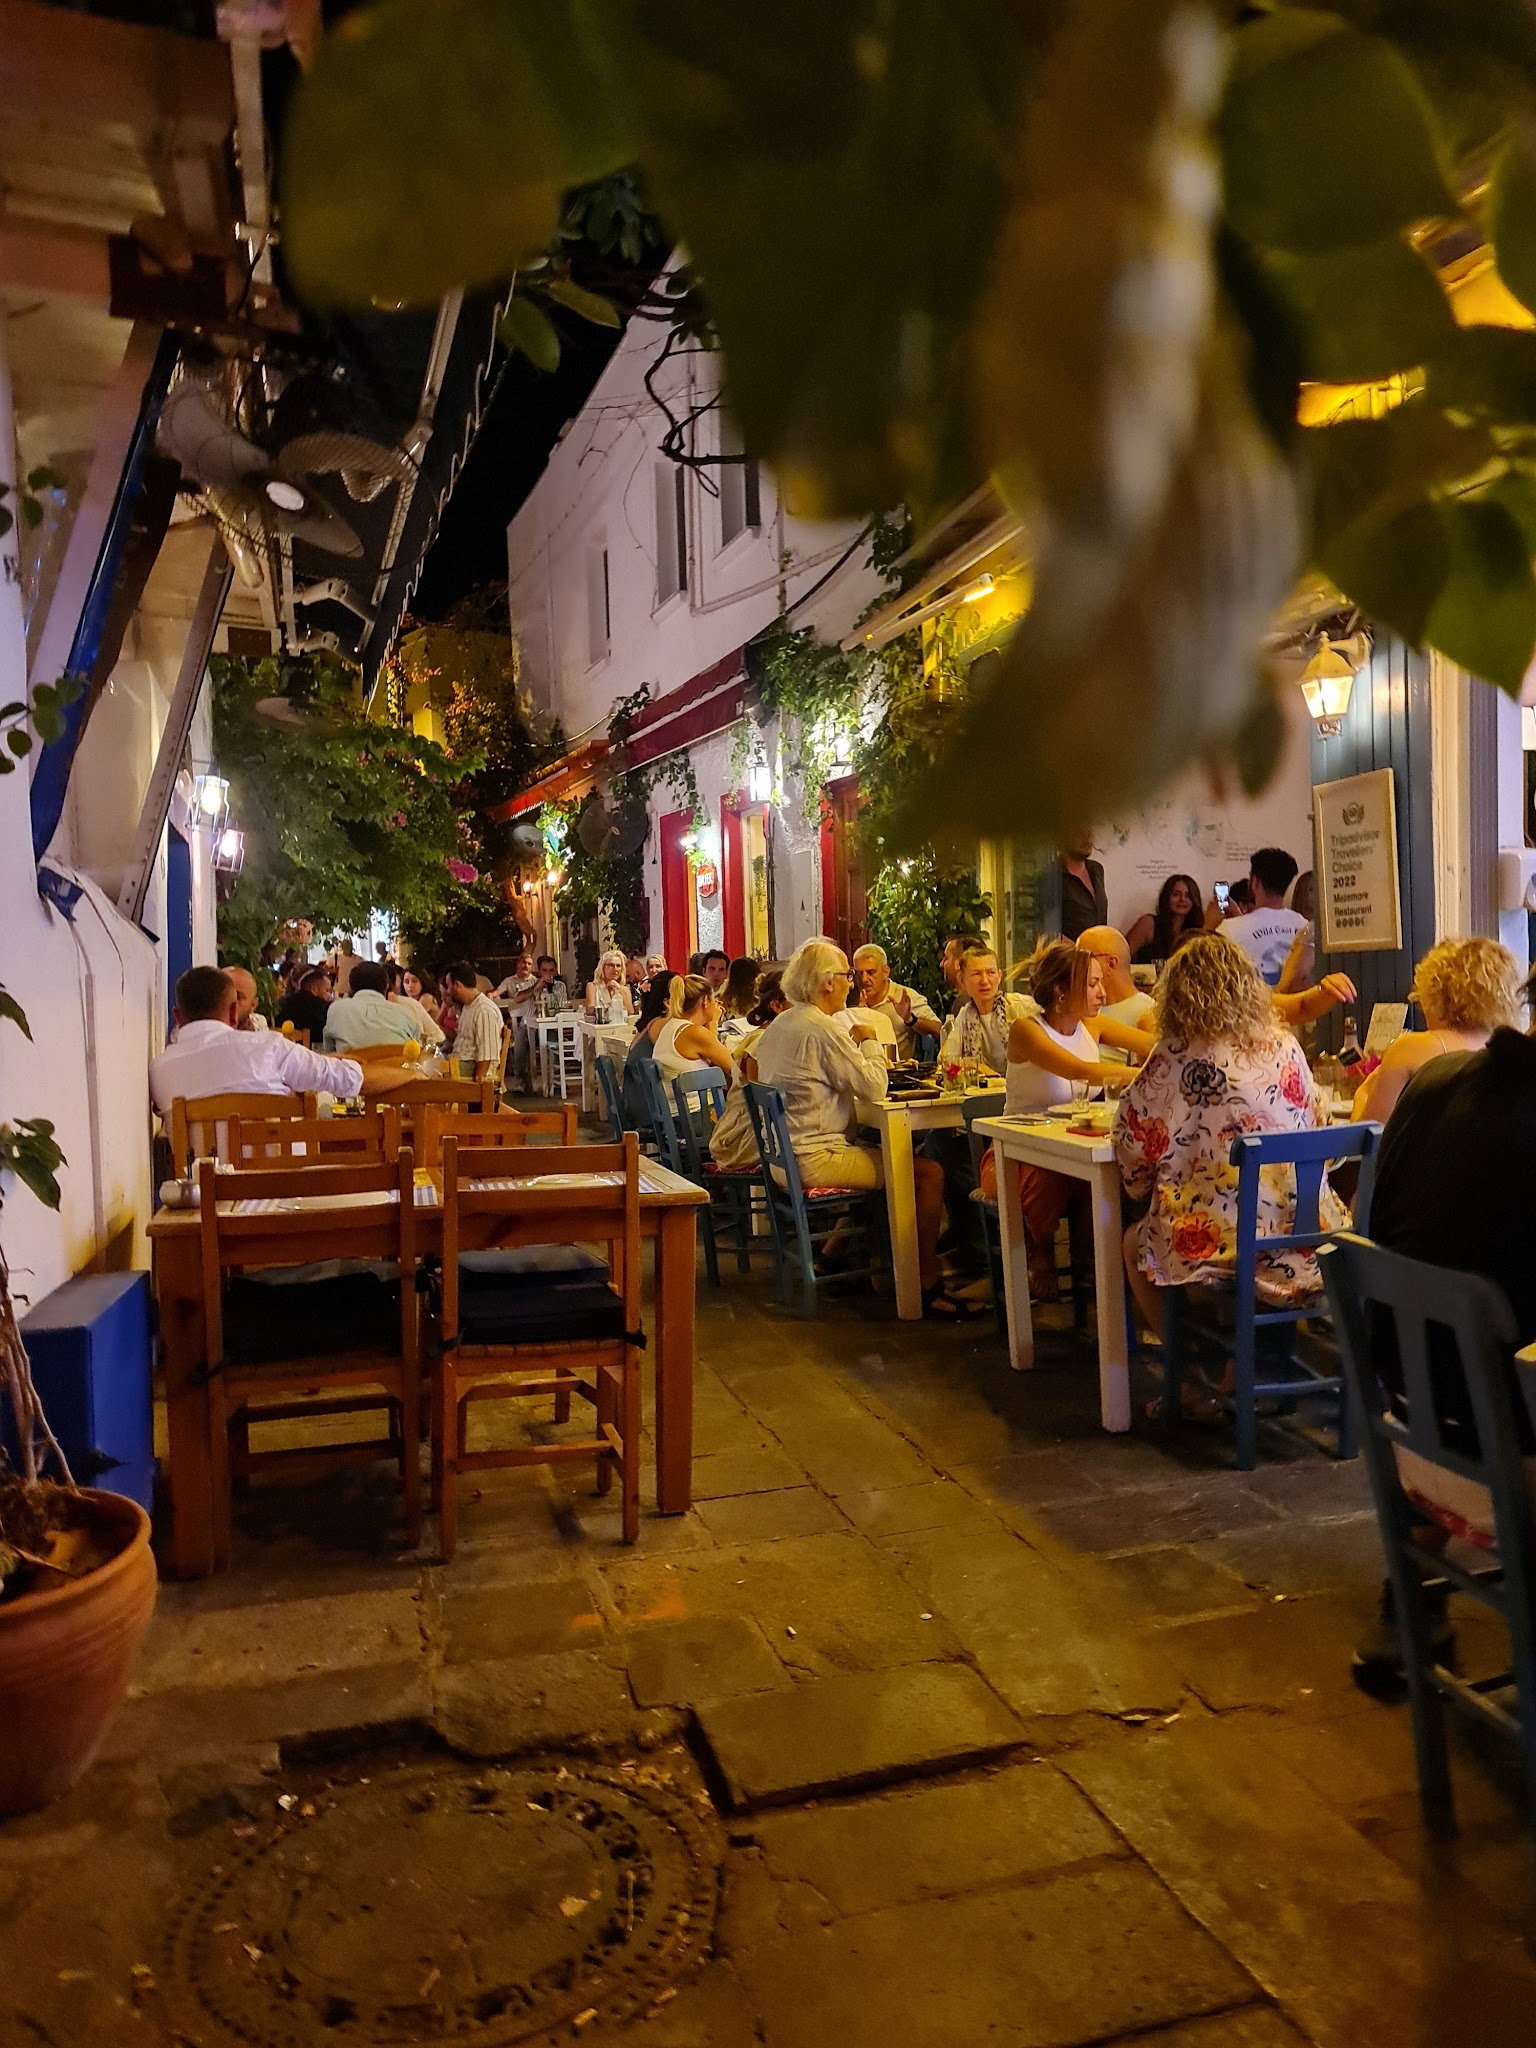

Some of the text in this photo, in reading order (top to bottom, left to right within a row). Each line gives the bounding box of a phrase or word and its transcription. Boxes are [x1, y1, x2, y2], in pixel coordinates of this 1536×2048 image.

[1330, 830, 1379, 846] Tripadvisor
[1332, 860, 1363, 873] Choice
[1332, 874, 1356, 889] 2022
[1334, 904, 1372, 916] Restaurant
[1252, 927, 1273, 939] Wild
